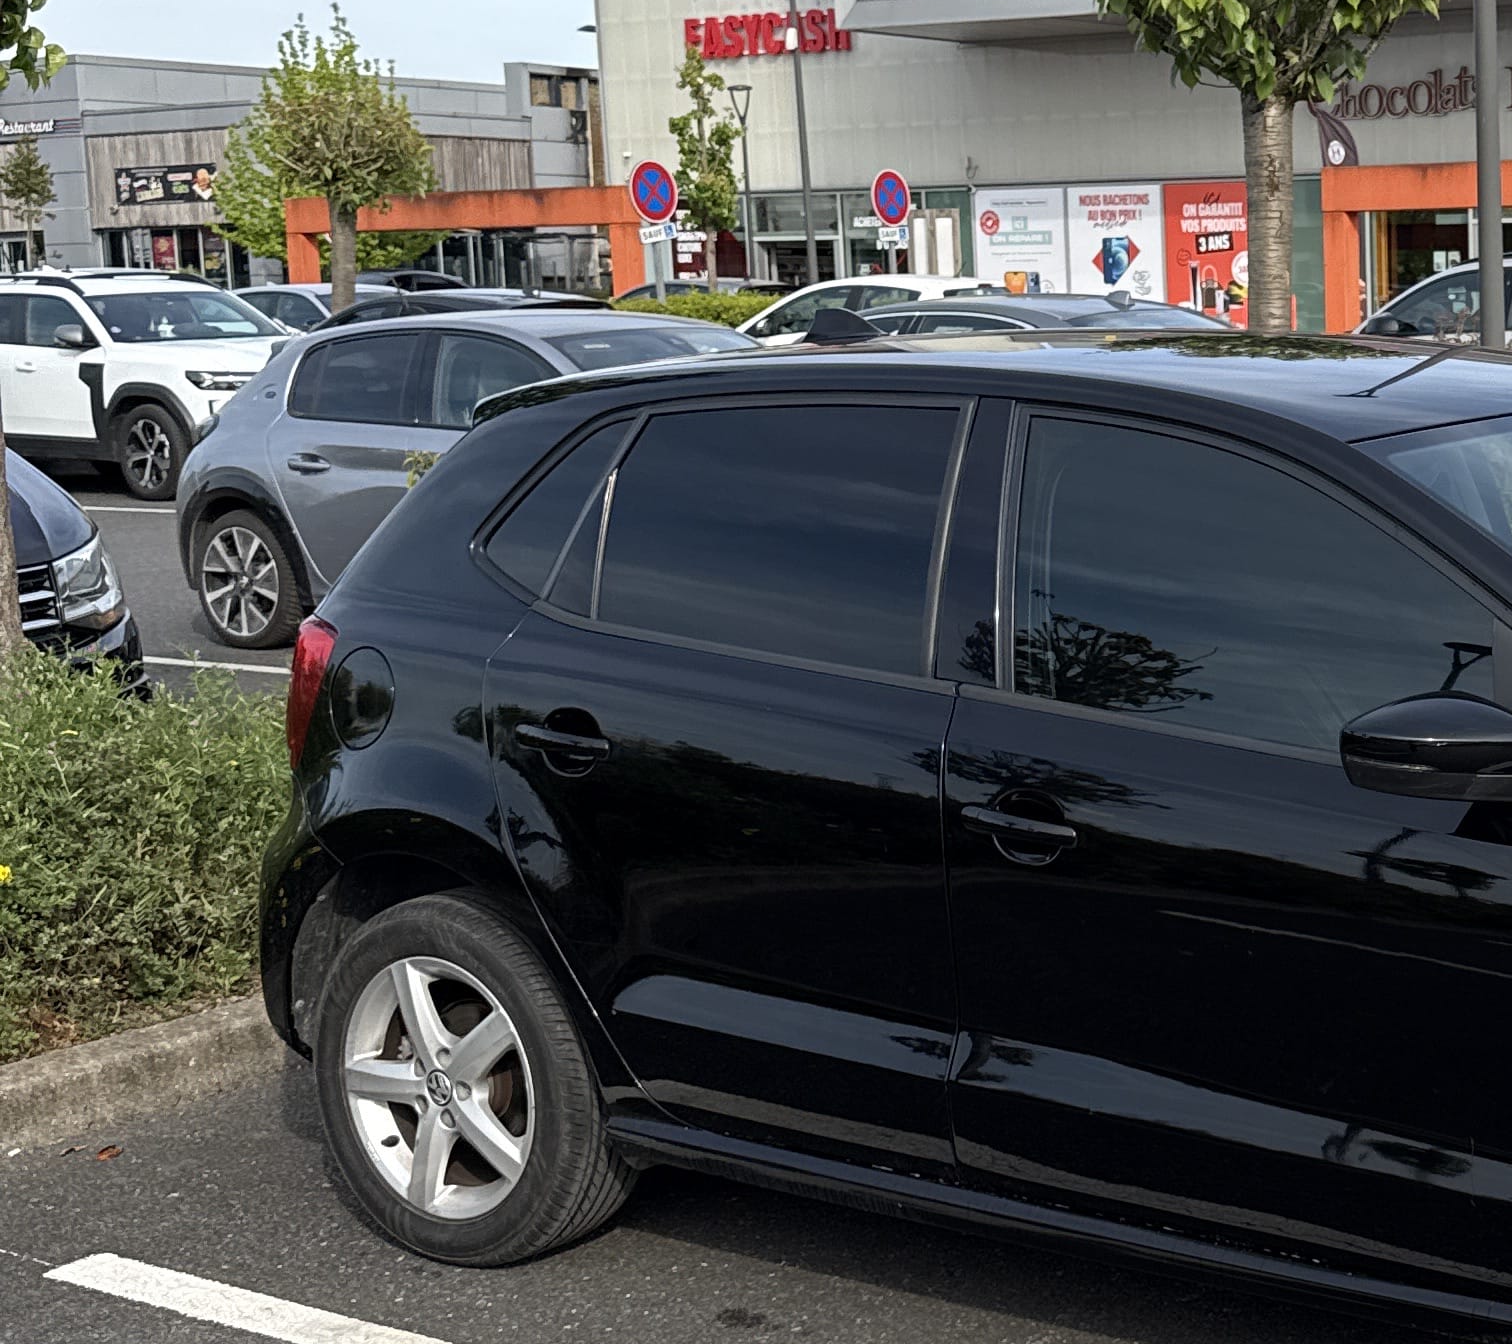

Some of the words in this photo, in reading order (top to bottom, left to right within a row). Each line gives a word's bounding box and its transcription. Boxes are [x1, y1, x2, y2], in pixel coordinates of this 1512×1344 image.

[1333, 66, 1478, 120] hocolat
[1079, 195, 1101, 206] NOUS
[1182, 204, 1197, 217] ON
[1198, 202, 1243, 216] GARANTIT
[1180, 219, 1200, 233] VOS
[1201, 218, 1247, 232] PRODUITS
[643, 229, 662, 240] SAUF
[1198, 237, 1207, 252] 3
[1208, 234, 1230, 251] ANS
